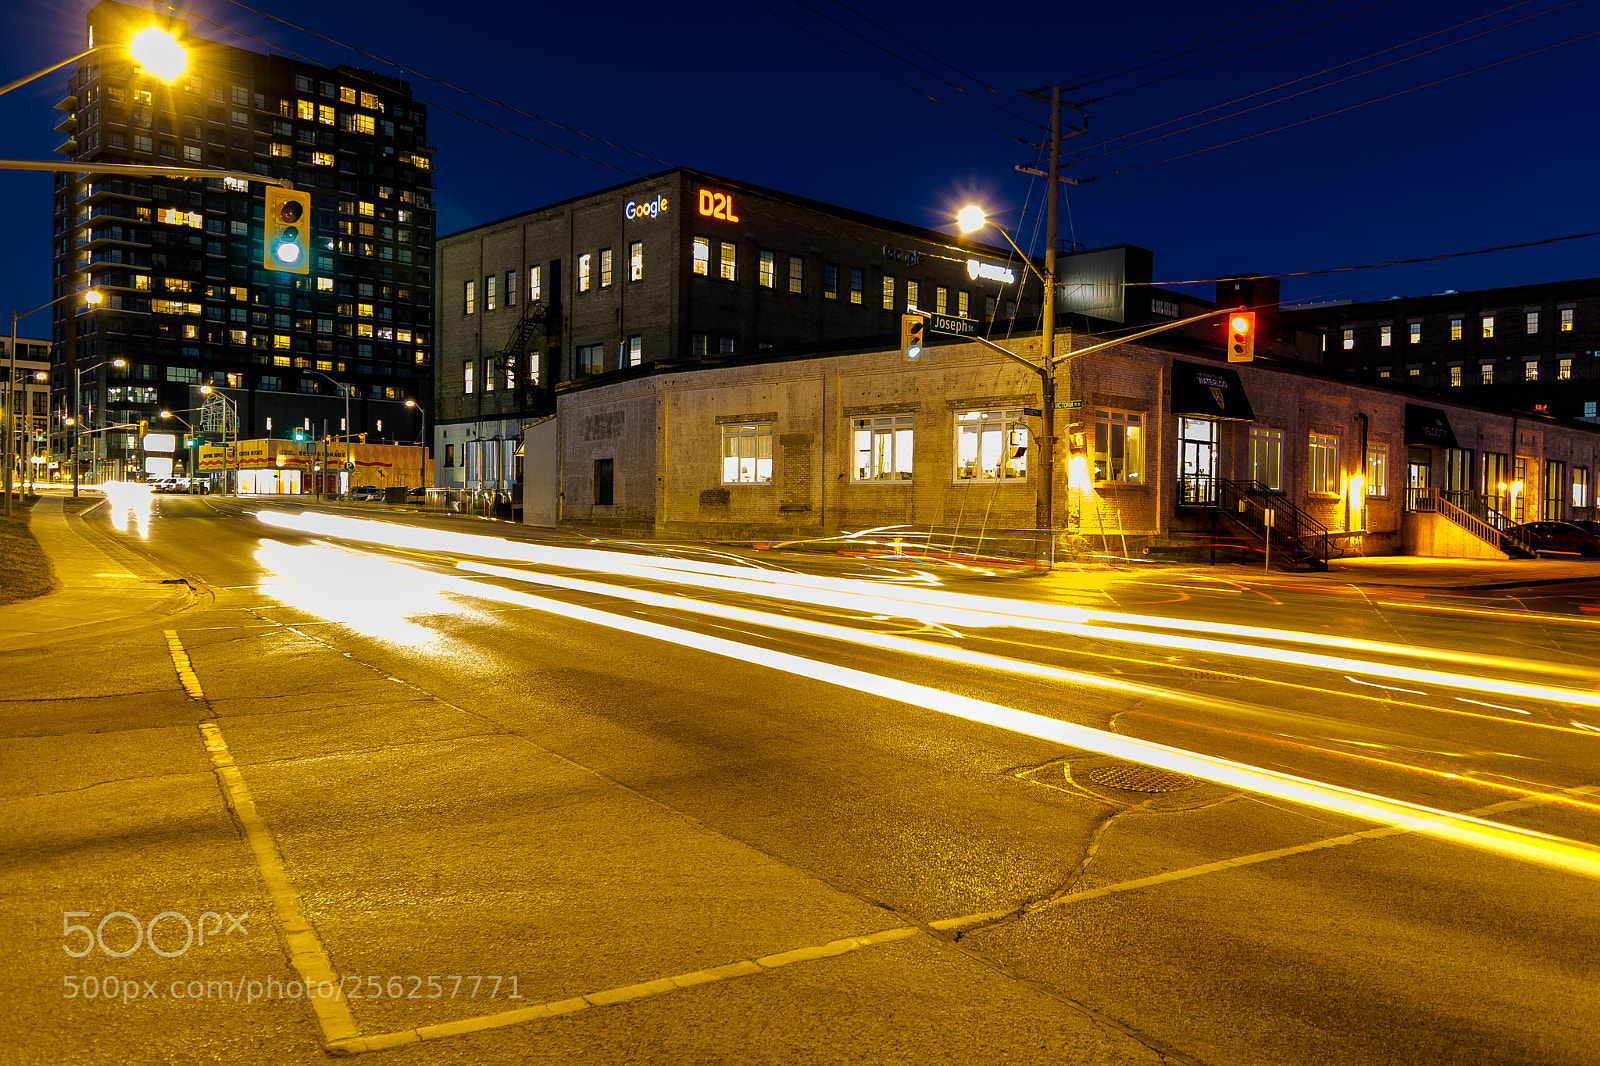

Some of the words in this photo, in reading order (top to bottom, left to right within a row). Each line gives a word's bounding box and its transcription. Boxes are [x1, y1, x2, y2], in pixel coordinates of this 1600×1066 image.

[625, 194, 668, 220] Google
[699, 189, 739, 223] D2L
[882, 243, 924, 268] Google
[934, 316, 968, 335] Joseph
